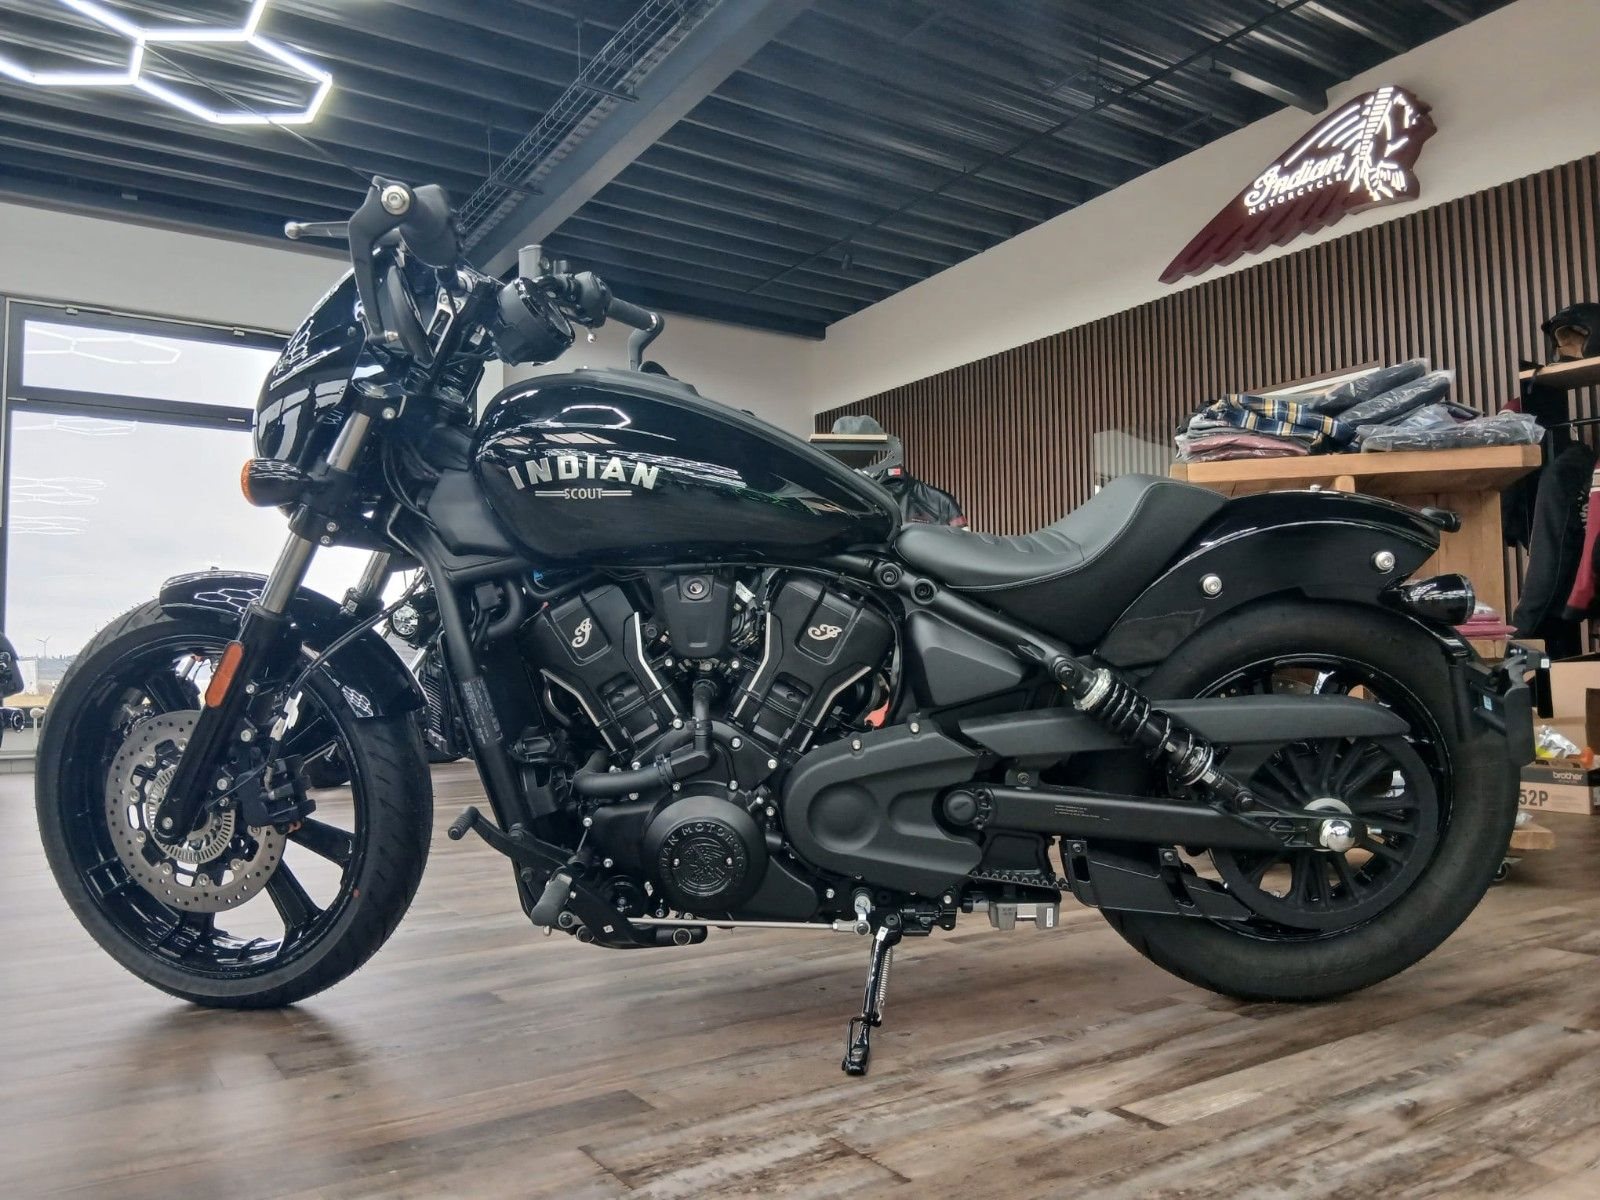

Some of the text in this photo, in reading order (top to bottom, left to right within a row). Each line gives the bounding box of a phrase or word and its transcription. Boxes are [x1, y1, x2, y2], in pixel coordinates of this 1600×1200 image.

[1244, 153, 1345, 207] Indian
[1248, 173, 1342, 216] MOTORCYCLE
[508, 455, 659, 490] INDIAN
[564, 487, 603, 500] SCOUT
[1552, 770, 1583, 780] brother
